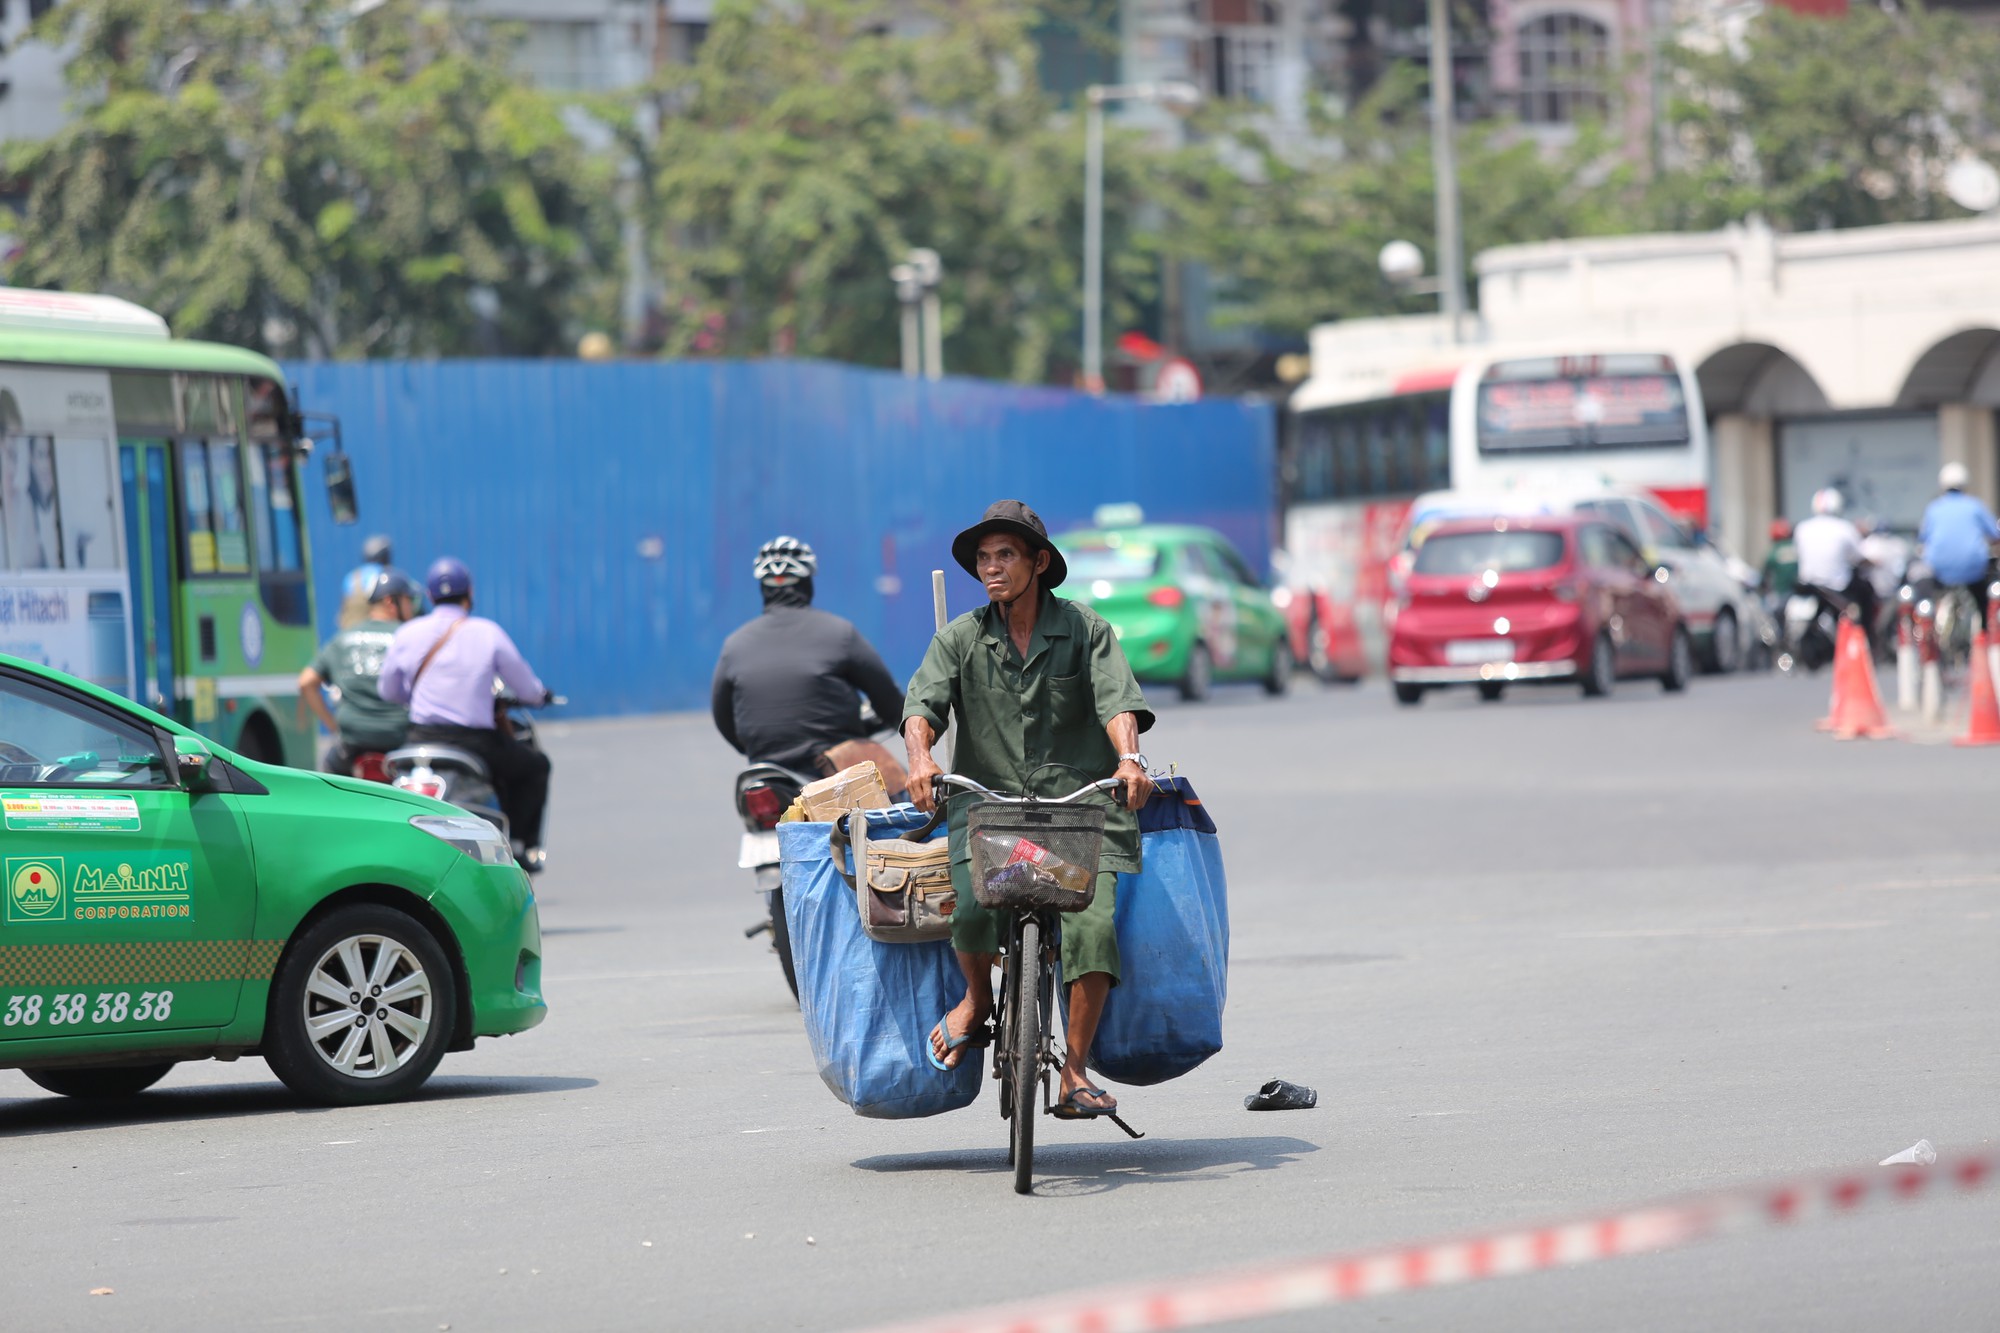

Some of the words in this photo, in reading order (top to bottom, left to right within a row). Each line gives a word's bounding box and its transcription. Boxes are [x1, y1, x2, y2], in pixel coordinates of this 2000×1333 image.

[74, 904, 190, 920] CORPORATION
[3, 994, 43, 1027] 38
[49, 993, 87, 1025] 38
[91, 991, 131, 1024] 38
[132, 990, 174, 1022] 38
